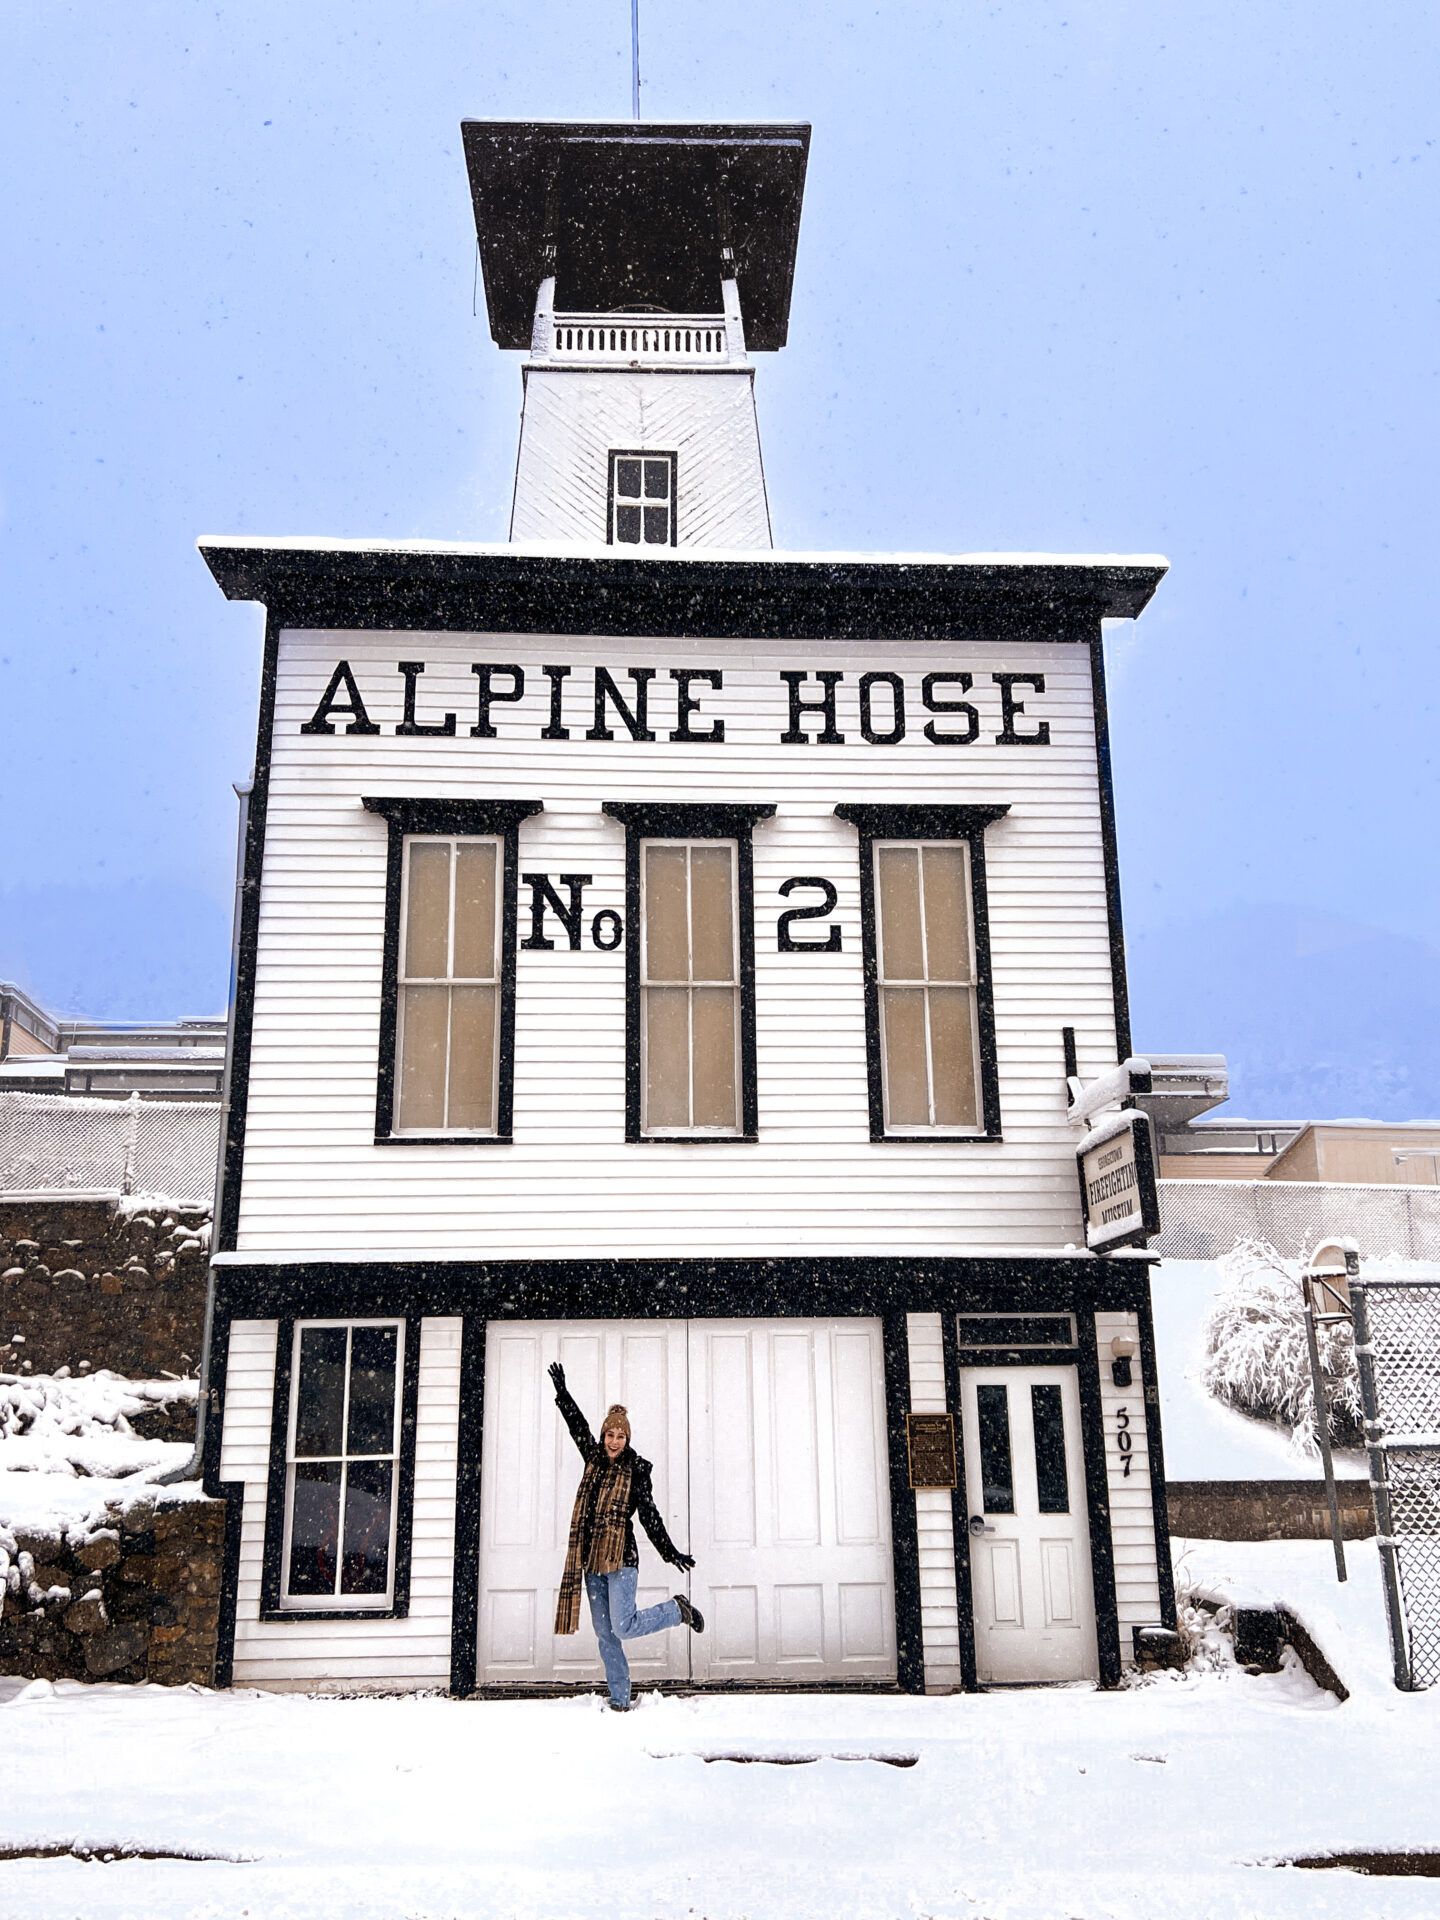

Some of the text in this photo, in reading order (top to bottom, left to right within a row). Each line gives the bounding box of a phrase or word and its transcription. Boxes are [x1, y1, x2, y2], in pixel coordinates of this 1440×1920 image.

[300, 660, 1051, 745] ALPINE HOSE
[520, 873, 842, 952] No 2
[1102, 1199, 1134, 1225] MUSEUM
